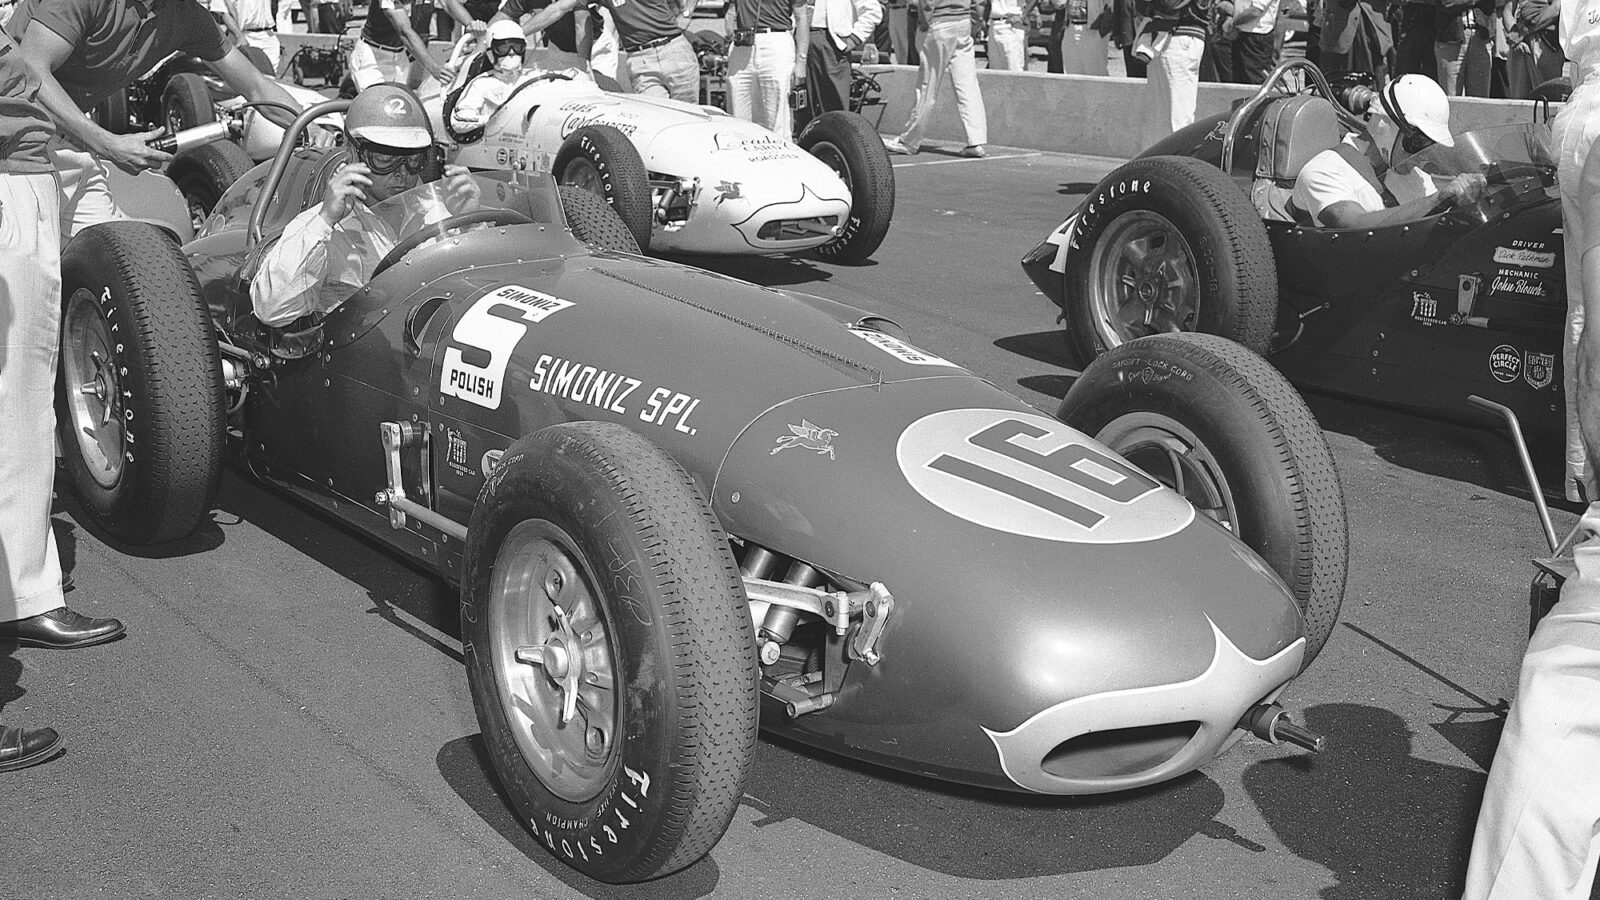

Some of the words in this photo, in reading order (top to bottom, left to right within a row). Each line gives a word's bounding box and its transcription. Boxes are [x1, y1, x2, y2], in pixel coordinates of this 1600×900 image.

[390, 98, 407, 115] 2
[580, 135, 614, 205] Fireston
[1069, 179, 1152, 251] Firestone
[1511, 239, 1546, 250] DRIVER
[1488, 275, 1516, 297] John
[1498, 268, 1540, 280] MECHANIC
[496, 287, 562, 312] SIMONIZ
[1492, 353, 1520, 365] PERFECT
[1492, 360, 1518, 372] CIRCLE
[100, 286, 136, 463] Firestone
[449, 368, 495, 400] POLISH
[529, 353, 643, 415] SIMONIZ
[639, 386, 701, 436] SPL.
[923, 418, 1165, 532] 16
[530, 762, 651, 863] Firestone
[545, 811, 589, 831] CHAMPION
